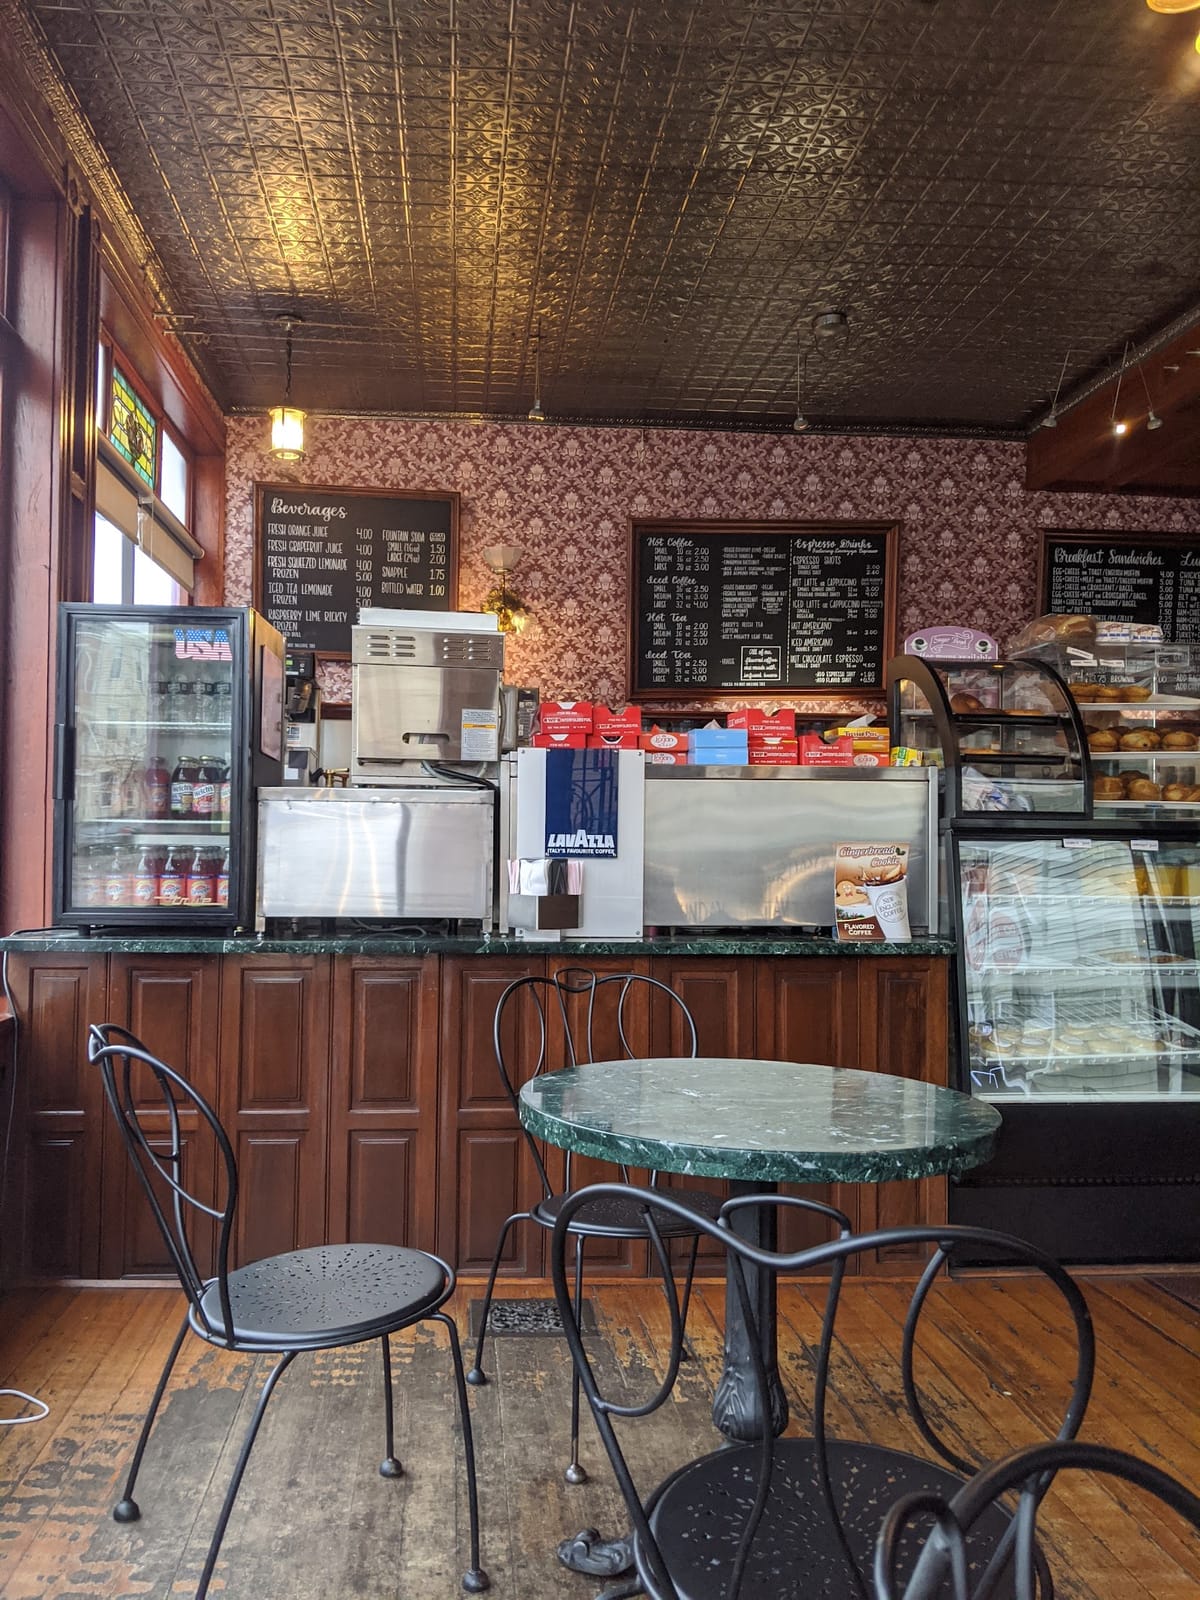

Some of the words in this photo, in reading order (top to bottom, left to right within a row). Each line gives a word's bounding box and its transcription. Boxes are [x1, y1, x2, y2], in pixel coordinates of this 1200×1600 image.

[271, 498, 347, 521] Beverages
[268, 523, 286, 535] FRESH
[288, 525, 311, 536] ORANGE
[312, 526, 328, 537] JUICE
[356, 528, 372, 539] 4.00
[383, 530, 408, 541] FOUNTAIN
[411, 531, 425, 542] SODA
[268, 539, 286, 551] FRESH
[289, 541, 323, 552] GRAPEFRUIT
[325, 543, 342, 553] JUICE
[356, 545, 372, 555] 4.00
[387, 542, 402, 552] SMALL
[430, 544, 445, 553] 1.50
[647, 538, 664, 546] Hot
[668, 538, 694, 547] Coffee
[794, 539, 836, 551] Espresso
[840, 539, 872, 548] Drinks
[268, 556, 286, 567] FRESH
[288, 557, 316, 568] SQUEEZED
[319, 558, 347, 570] LEMONADE
[356, 560, 372, 571] 4.00
[387, 553, 402, 562] LARGE
[429, 555, 445, 565] 2.00
[793, 556, 819, 565] ESPRESSO
[824, 556, 841, 565] SHOTS
[1055, 547, 1104, 568] Breakfast
[1108, 549, 1165, 566] Sandwiches
[382, 566, 408, 578] SNAPPLE
[430, 569, 445, 580] 1.75
[694, 563, 709, 571] 3.00
[273, 568, 299, 578] FROZEN
[356, 572, 372, 581] 5.00
[647, 576, 668, 584] Iced
[672, 576, 696, 585] Coffee
[792, 578, 801, 586] HOT
[804, 578, 817, 586] LATTE
[827, 578, 856, 586] CAPPUCCINO
[268, 582, 283, 593] ICED
[287, 583, 297, 594] TEA
[302, 584, 333, 596] LEMONADE
[356, 586, 371, 597] 4.00
[382, 582, 403, 593] BOTTLED
[406, 584, 423, 594] WATER
[430, 585, 444, 596] 1.00
[273, 595, 297, 605] FROZEN
[356, 598, 371, 608] 5.00
[793, 600, 804, 608] ICED
[806, 600, 820, 608] LATTE
[830, 600, 860, 608] CAPPUCCINO
[268, 609, 302, 620] RASPBERRY
[306, 610, 320, 621] LIME
[324, 612, 347, 622] RICKEY
[646, 613, 665, 622] Hot
[670, 613, 687, 621] Tea
[273, 622, 297, 631] FROZEN
[803, 622, 832, 630] AMERICANO
[174, 629, 232, 660] USA
[792, 638, 802, 646] ICED
[804, 638, 833, 646] AMERICANO
[671, 650, 692, 658] Tea
[790, 655, 800, 663] HOT
[802, 655, 832, 663] CHOCOLATE
[836, 655, 863, 663] ESPRESSO
[548, 829, 614, 848] LAVAZZA
[840, 846, 895, 858] Gingerbread
[871, 856, 900, 867] Cookie
[883, 909, 903, 918] COFFEE
